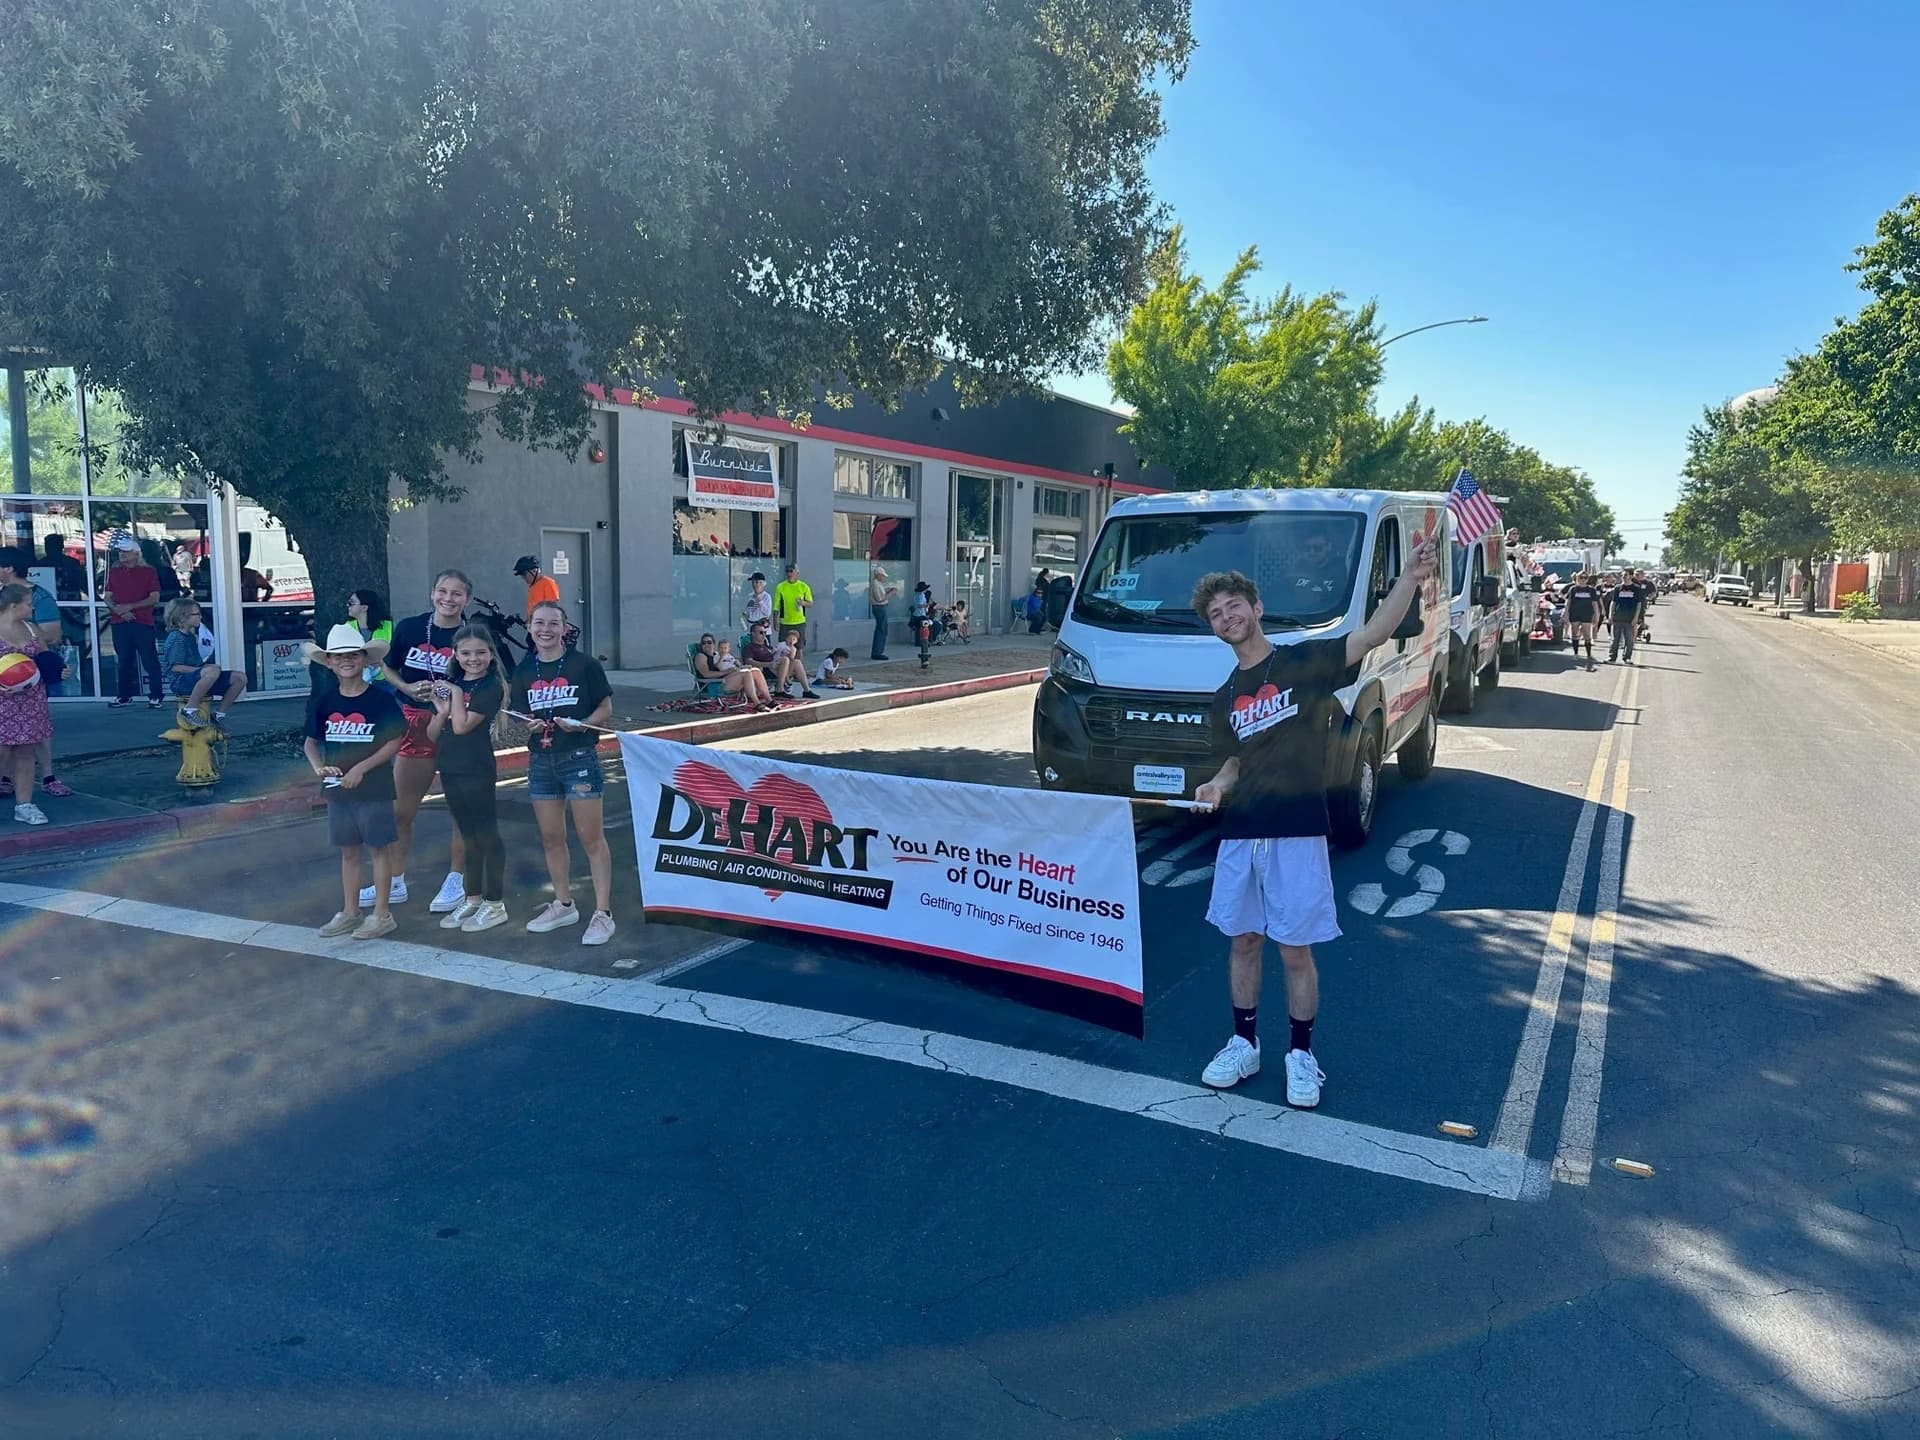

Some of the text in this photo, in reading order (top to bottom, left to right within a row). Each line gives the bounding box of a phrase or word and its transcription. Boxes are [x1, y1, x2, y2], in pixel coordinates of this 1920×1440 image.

[700, 449, 765, 472] Burnside
[1111, 577, 1136, 587] 030
[1126, 710, 1202, 724] RAM
[661, 853, 886, 899] PLUMBING AIR CONDITIONING HEATING
[887, 834, 1076, 885] You Are the Heart
[947, 867, 1125, 921] of Our Business
[920, 892, 1124, 952] Getting Things Fixed Since 1946
